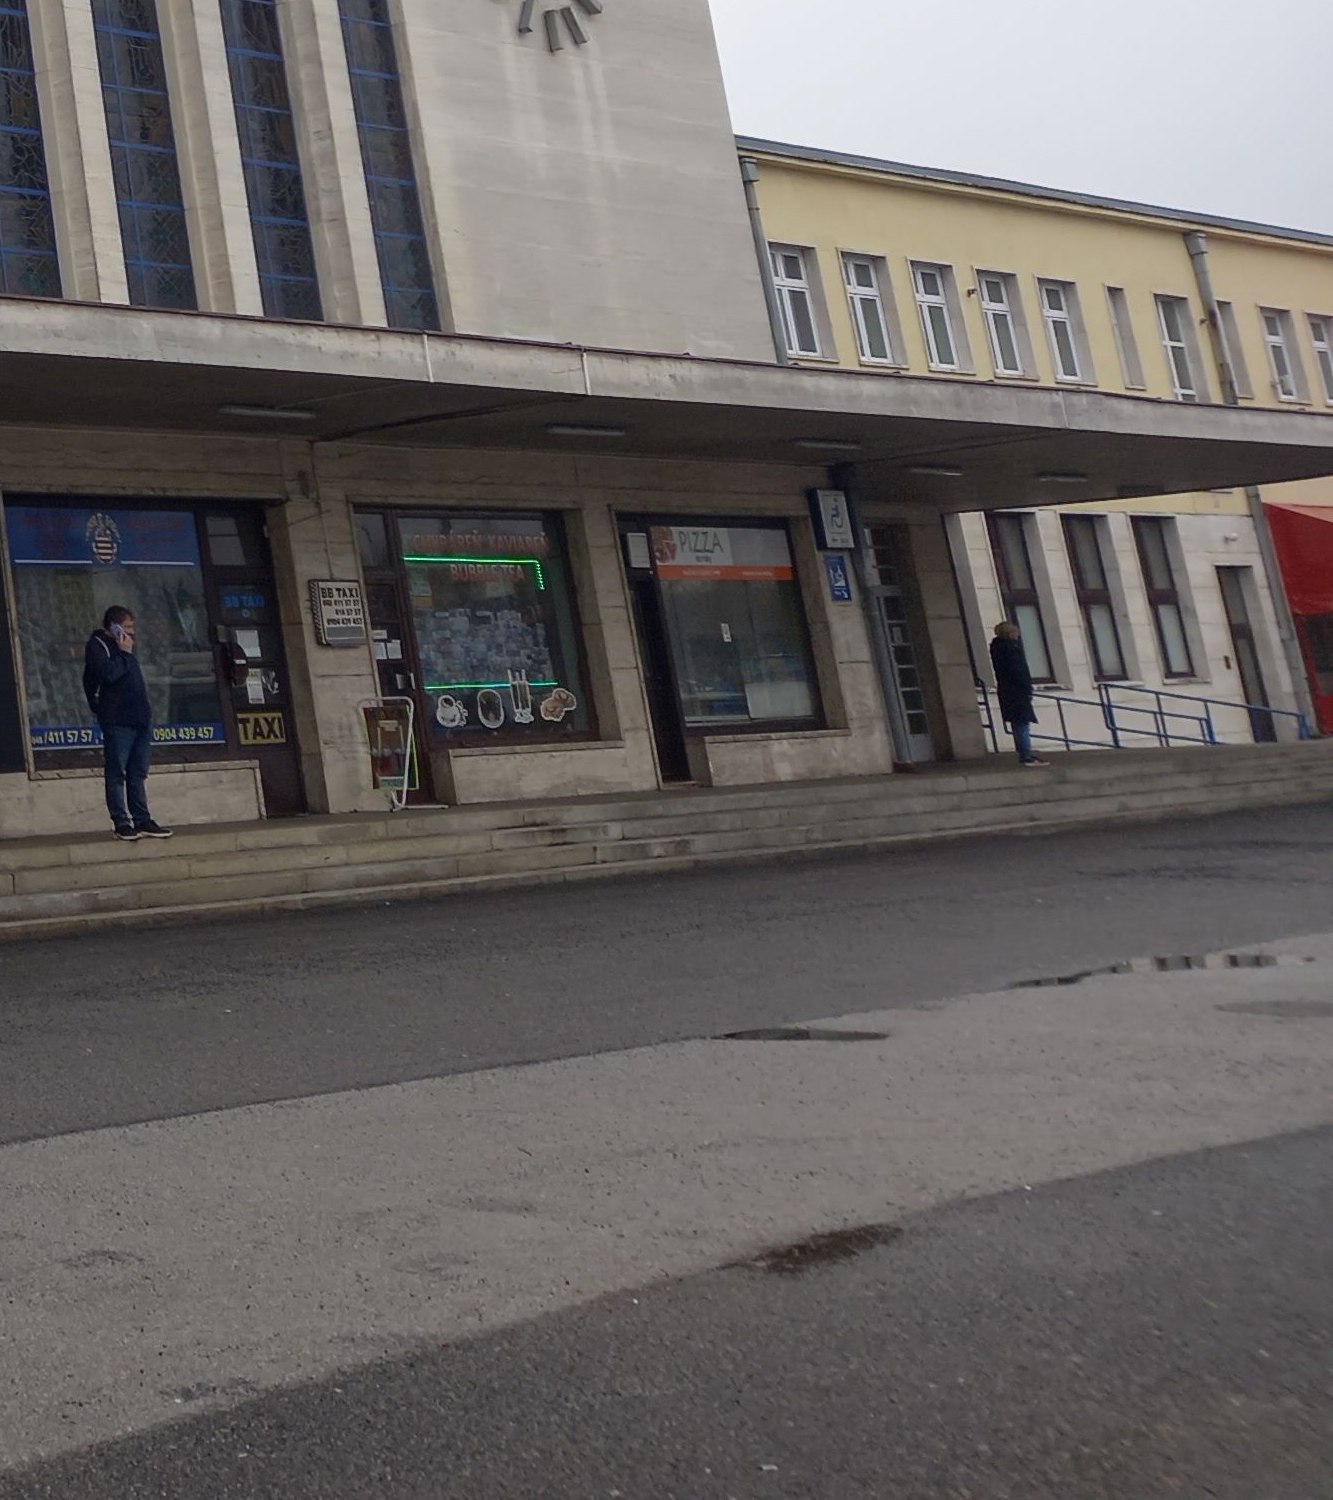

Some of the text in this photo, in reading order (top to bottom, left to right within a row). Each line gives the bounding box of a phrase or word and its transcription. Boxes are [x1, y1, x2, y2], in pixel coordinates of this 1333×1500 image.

[677, 530, 724, 554] PIZZA
[499, 563, 526, 581] TEA
[334, 588, 359, 599] TAXI
[153, 727, 177, 741] 0904
[197, 725, 214, 740] 457
[238, 716, 285, 741] TAXI
